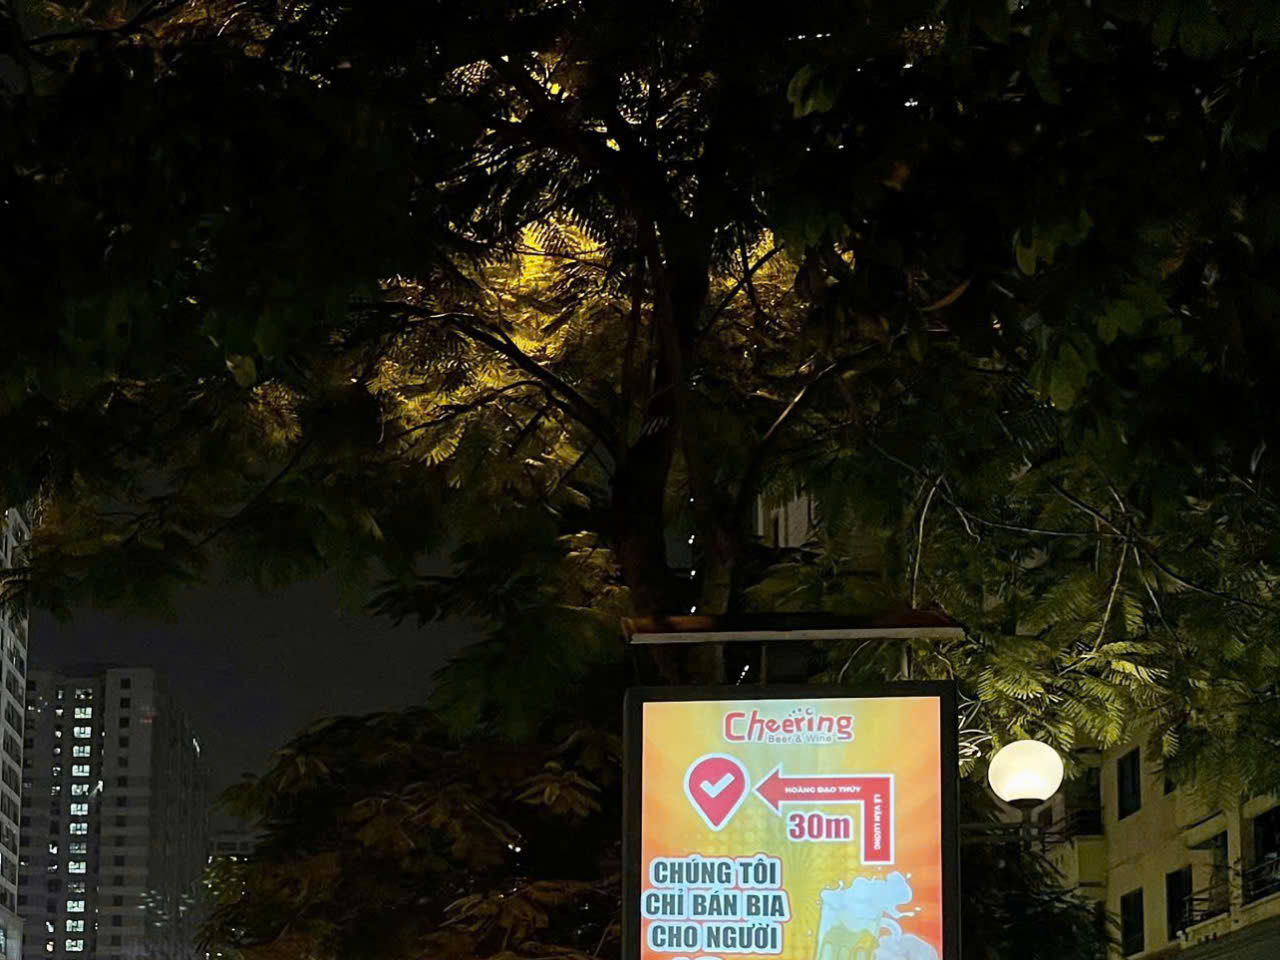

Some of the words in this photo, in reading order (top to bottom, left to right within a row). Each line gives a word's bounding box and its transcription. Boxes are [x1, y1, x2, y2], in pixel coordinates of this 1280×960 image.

[724, 709, 853, 742] Cheering
[768, 734, 792, 744] Beer
[795, 734, 802, 743] &
[806, 734, 833, 743] Wine
[788, 812, 851, 840] 30m
[653, 857, 732, 884] CHÚNG
[739, 857, 777, 885] TÔI
[645, 888, 684, 916] CHỈ
[692, 890, 738, 917] BÁN
[746, 894, 785, 917] BIA
[651, 924, 698, 948] CHO
[706, 923, 777, 949] NGƯỜI
